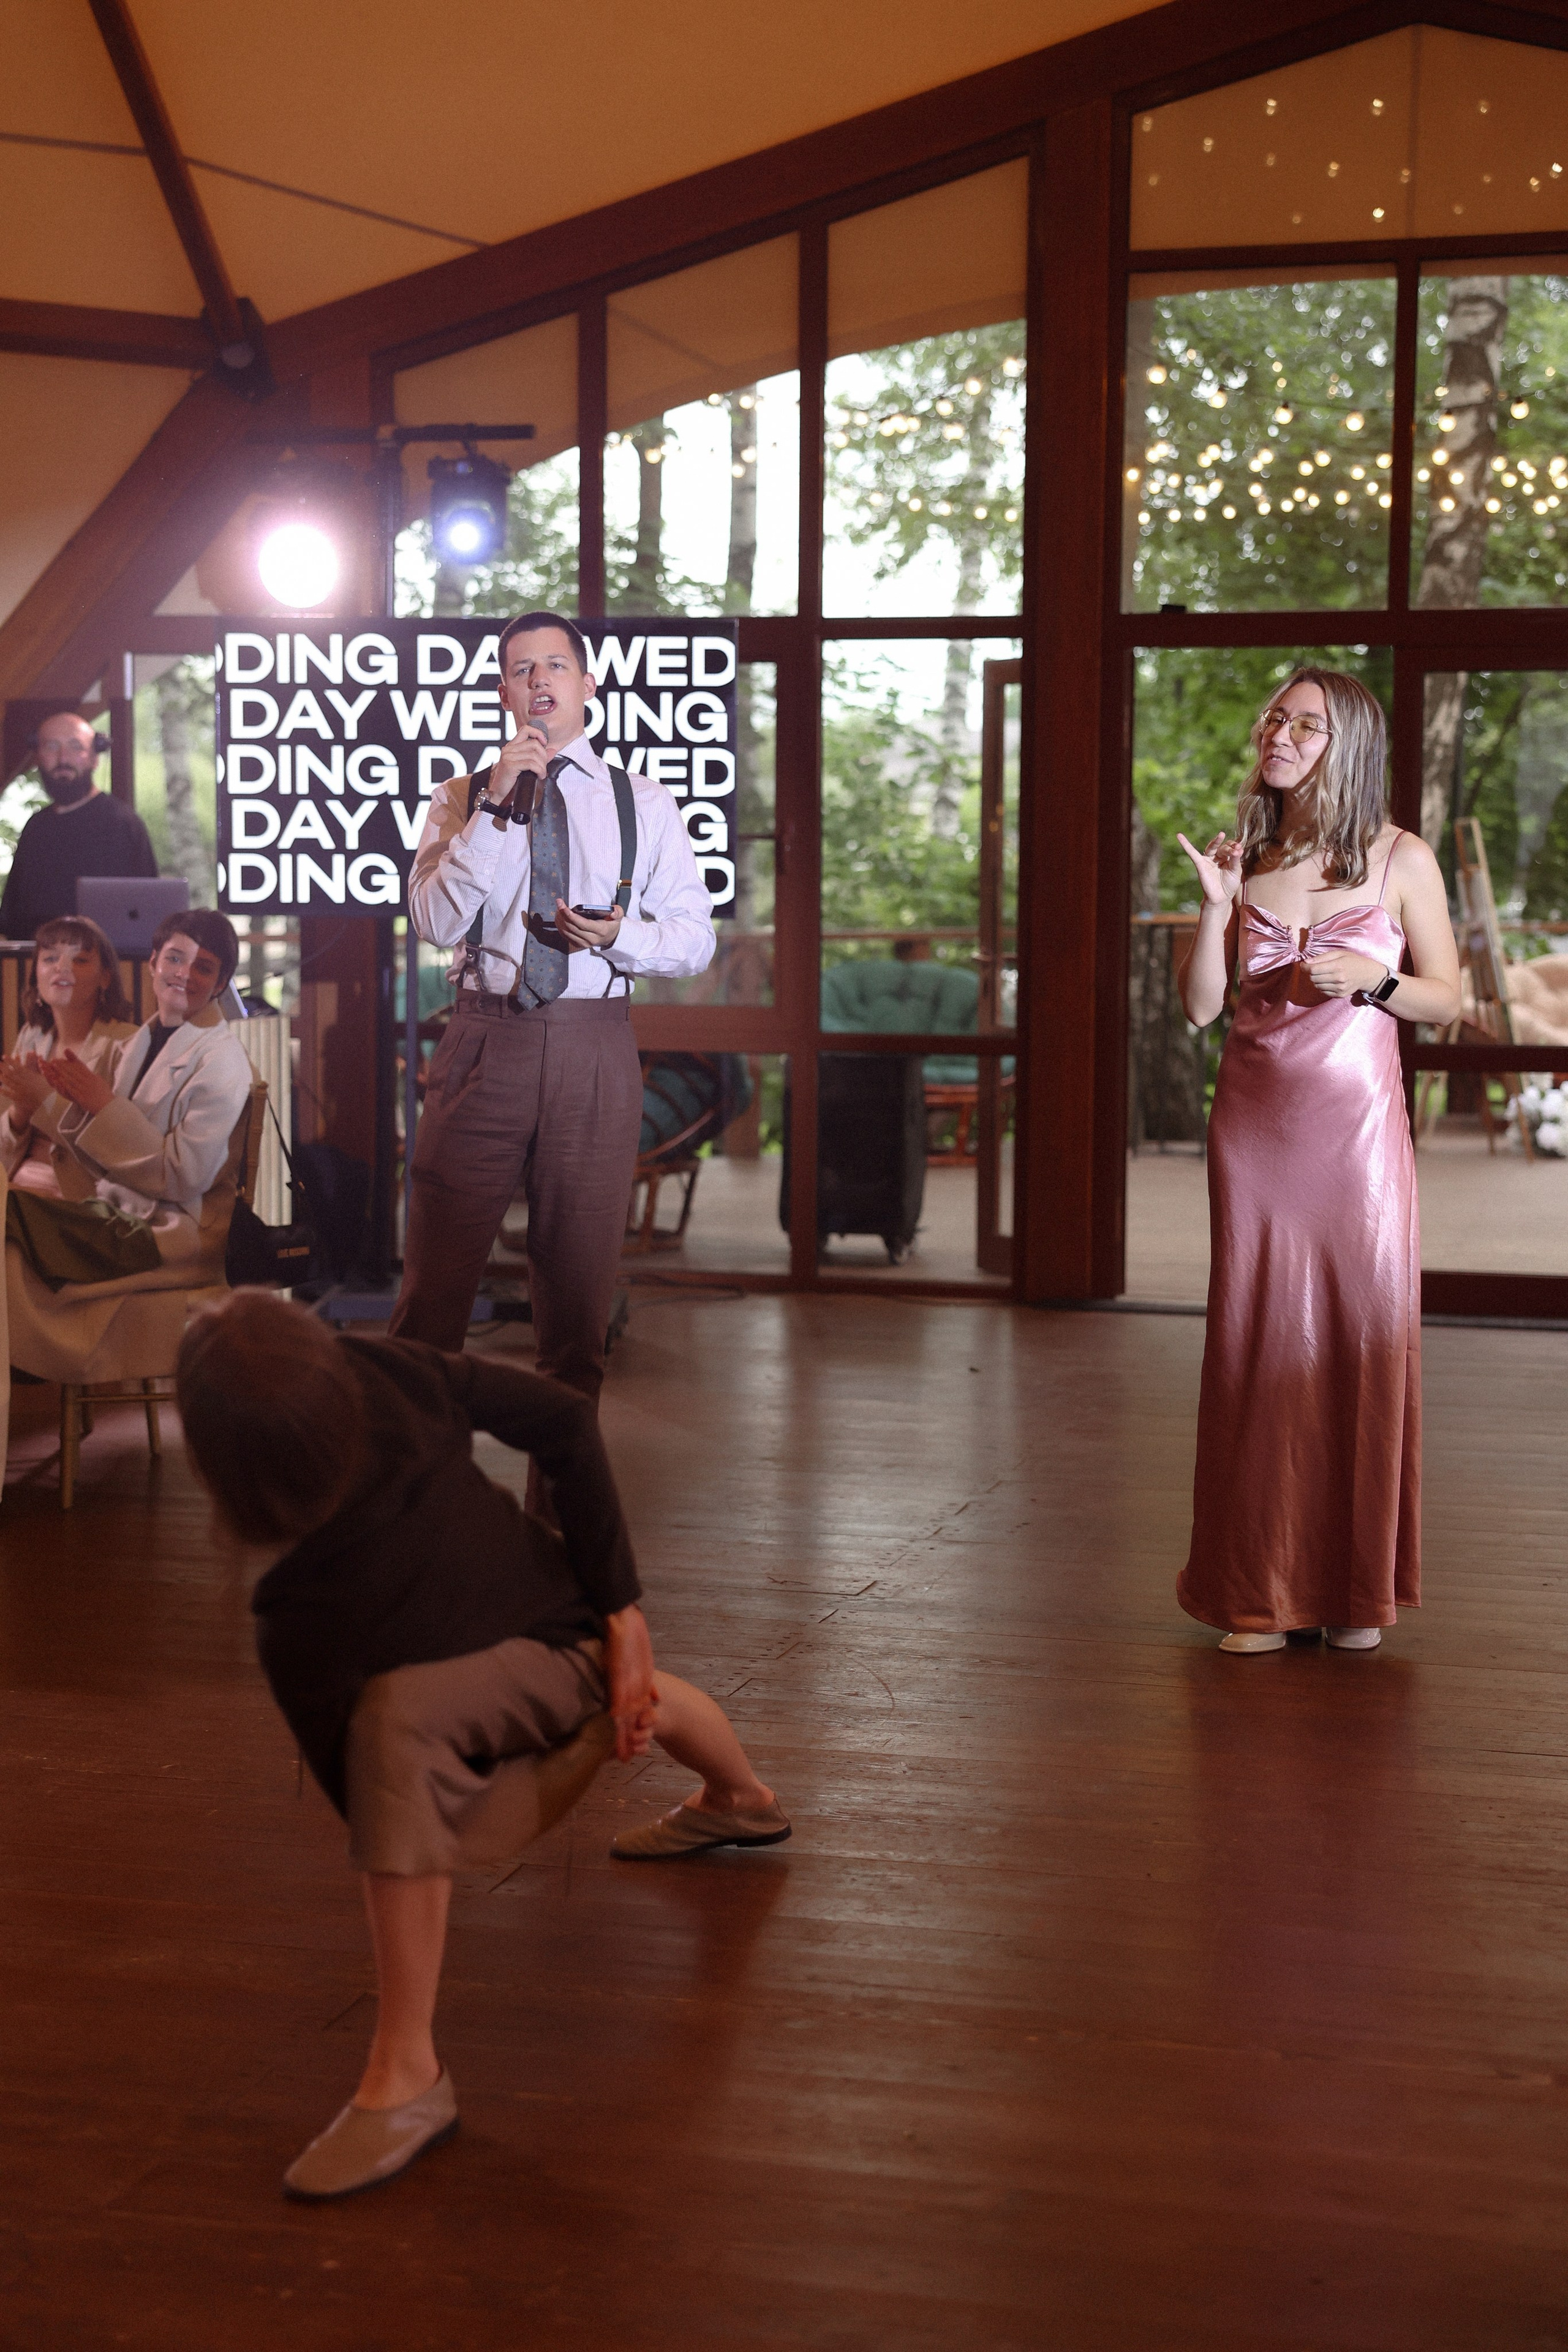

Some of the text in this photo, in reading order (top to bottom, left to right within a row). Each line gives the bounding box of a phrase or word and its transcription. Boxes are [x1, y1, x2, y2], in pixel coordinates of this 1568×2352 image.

[215, 632, 736, 687] DING DA WED
[230, 688, 728, 743] DAY WEING
[216, 744, 399, 796] DING
[232, 799, 379, 850] DAY
[217, 852, 401, 905] DING
